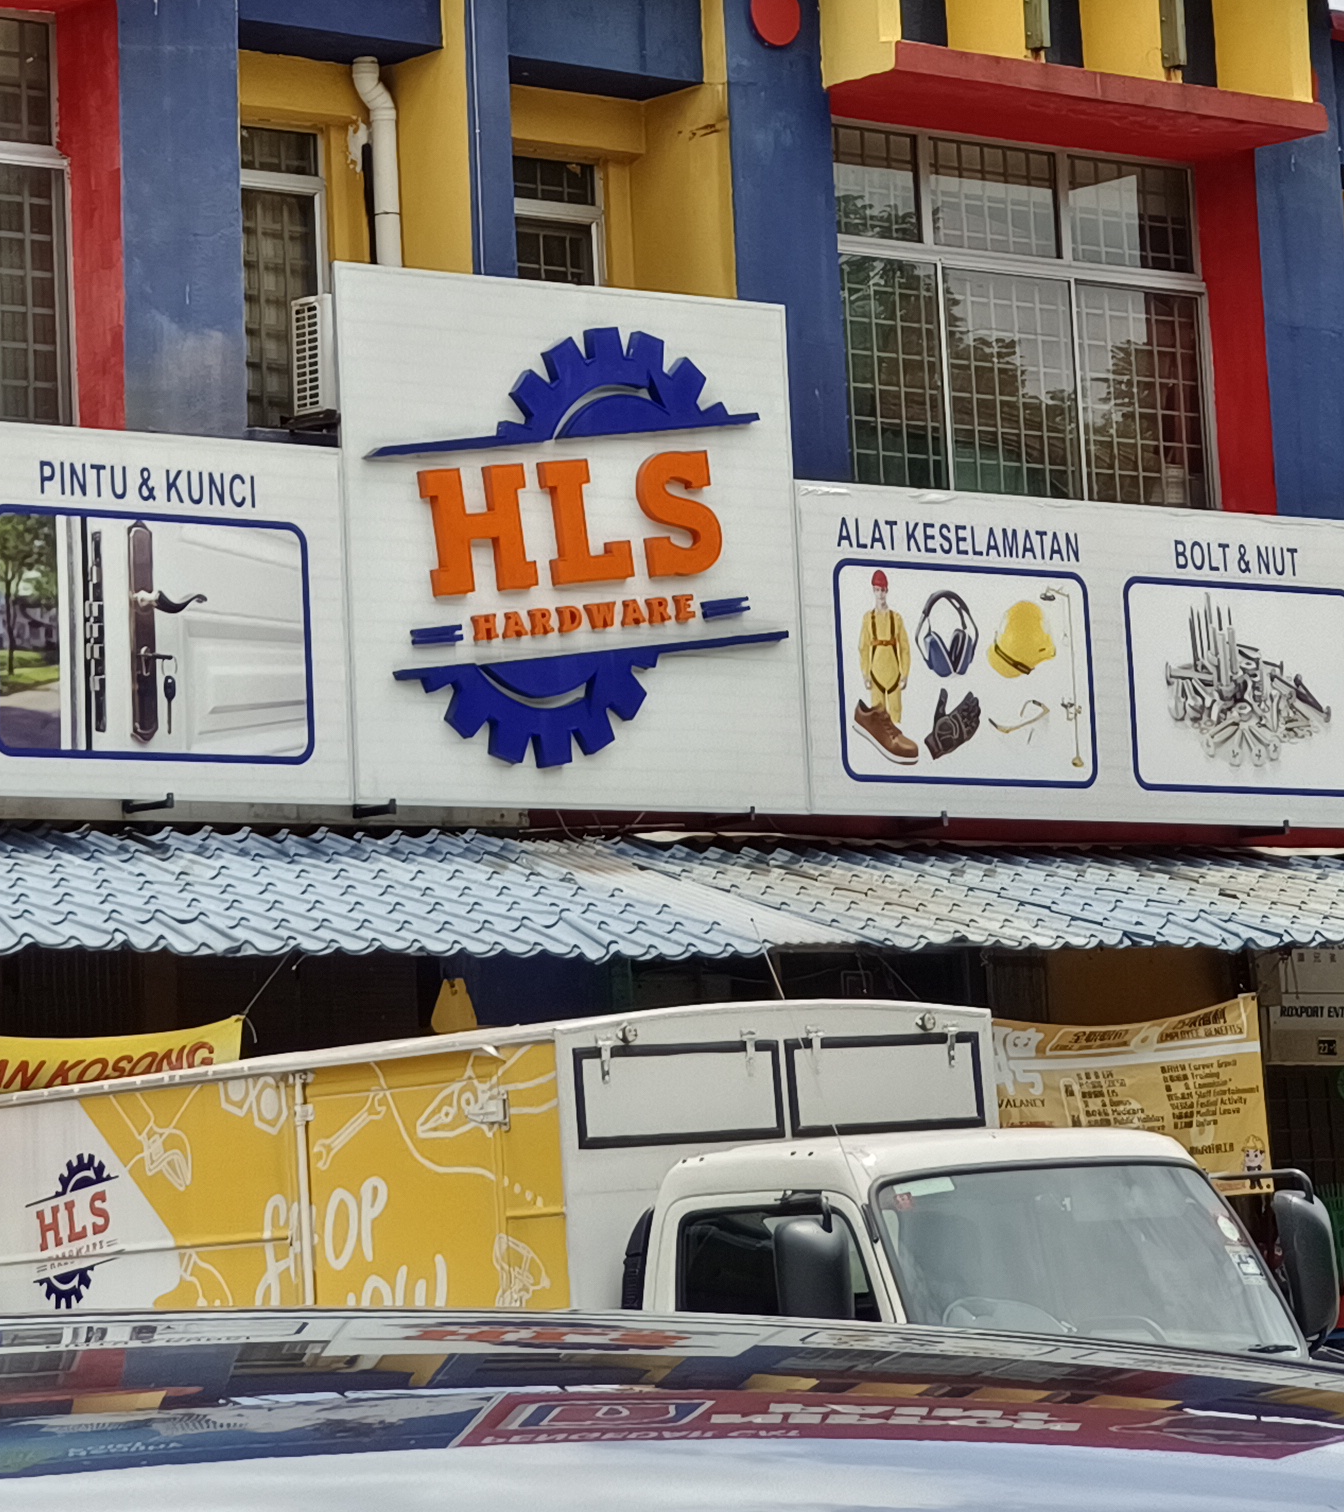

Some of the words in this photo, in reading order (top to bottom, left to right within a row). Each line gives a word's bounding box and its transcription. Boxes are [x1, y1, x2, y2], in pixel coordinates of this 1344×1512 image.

[38, 460, 128, 501] PINTU
[137, 470, 156, 502] &
[164, 468, 258, 509] KUNCI
[416, 449, 723, 598] HLS
[837, 516, 898, 552] ALAT
[904, 522, 1080, 563] KESELAMATAN
[1174, 539, 1231, 573] BOLT
[1237, 545, 1251, 574] &
[1255, 546, 1299, 578] NUT
[470, 594, 696, 643] HARDWARE
[1280, 1006, 1324, 1018] ROXPORT
[36, 1189, 110, 1252] HLS
